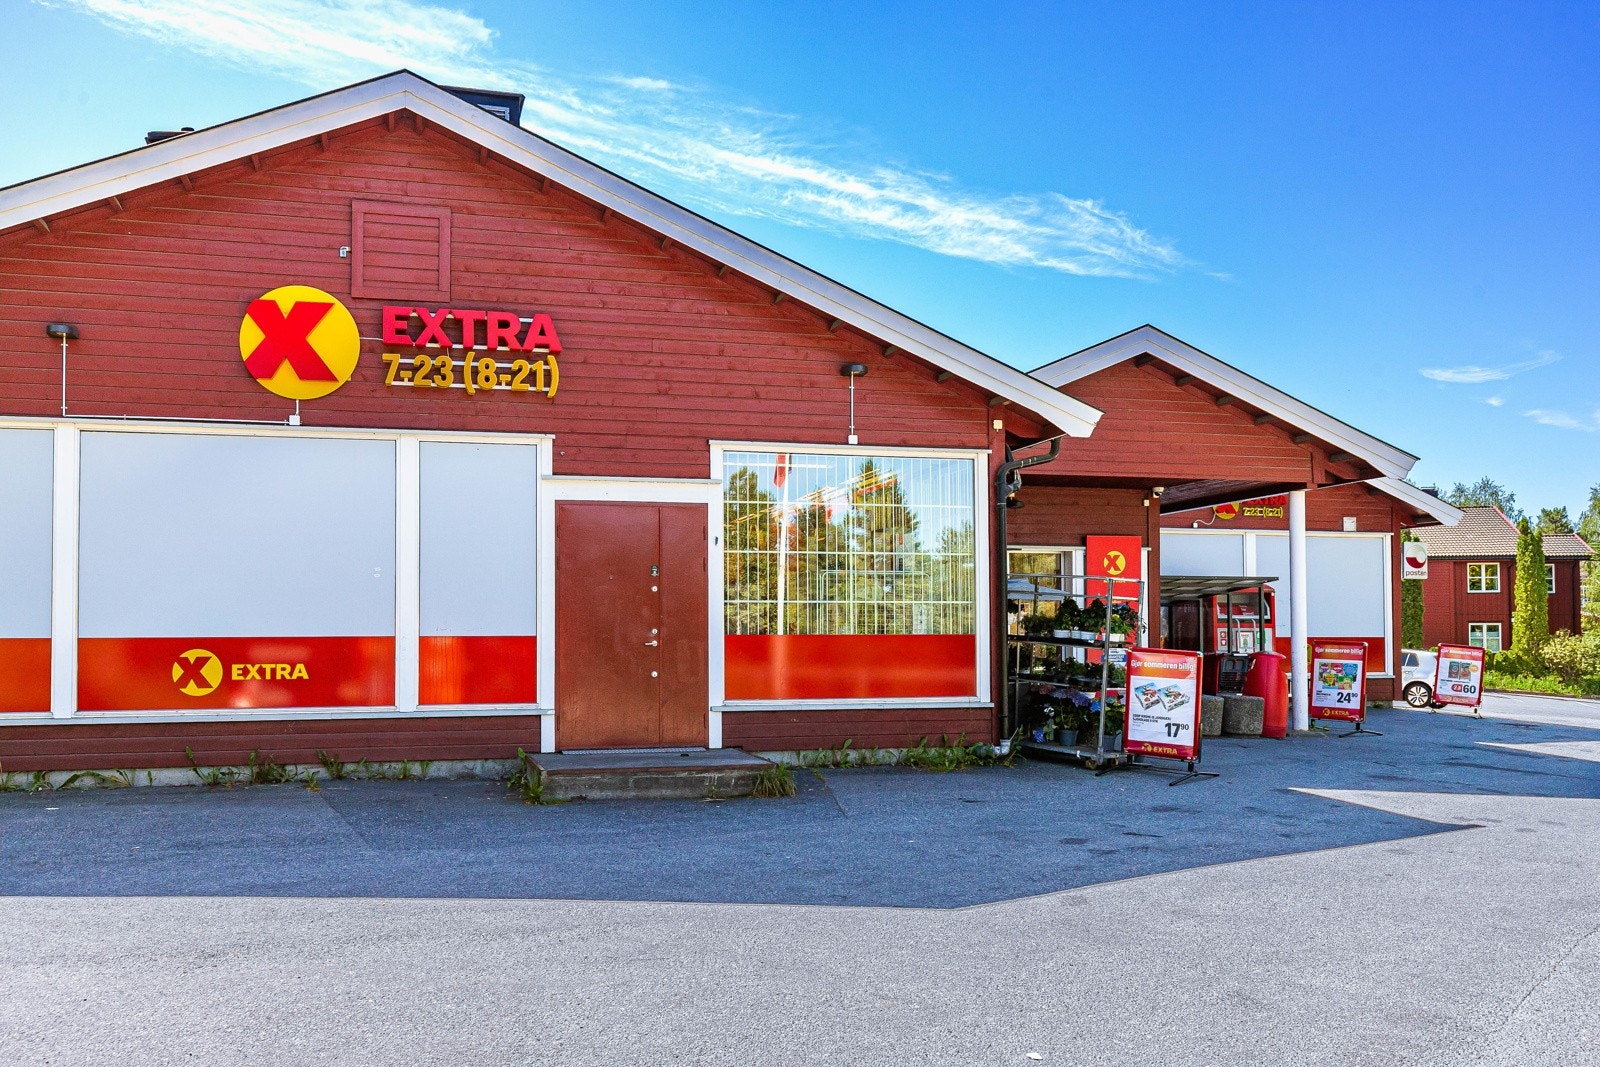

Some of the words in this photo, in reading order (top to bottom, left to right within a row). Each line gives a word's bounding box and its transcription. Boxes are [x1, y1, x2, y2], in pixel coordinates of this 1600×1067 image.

[382, 305, 563, 354] EXTRA
[382, 353, 455, 388] 7-23
[463, 351, 560, 399] (8-21)
[231, 663, 310, 681] EXTRA
[1143, 661, 1178, 669] sommeren
[1462, 684, 1476, 694] 60
[1153, 746, 1178, 755] EXTRA
